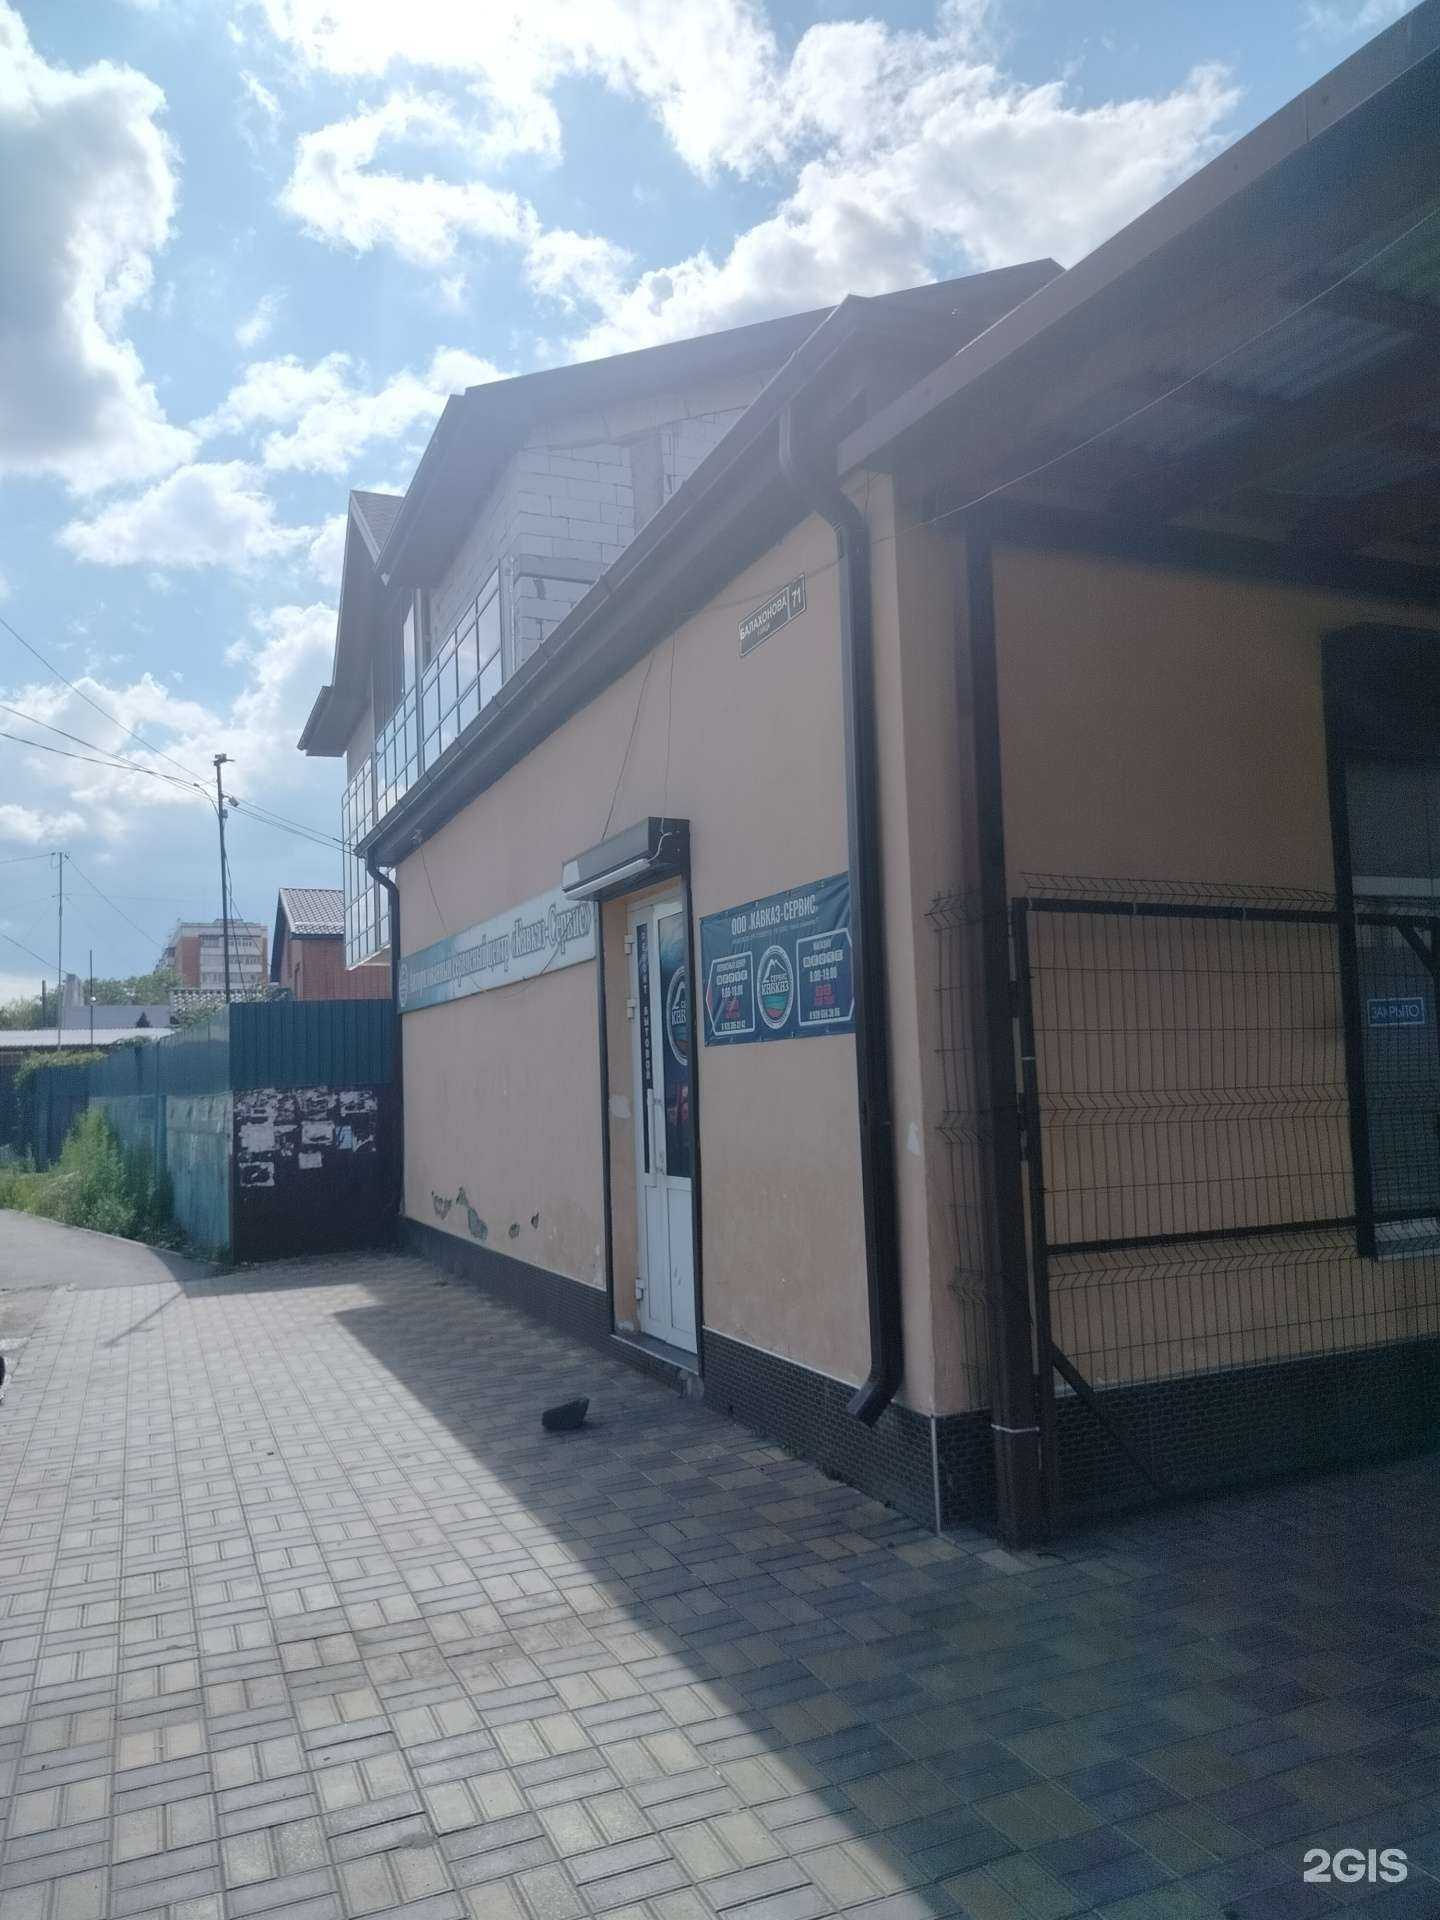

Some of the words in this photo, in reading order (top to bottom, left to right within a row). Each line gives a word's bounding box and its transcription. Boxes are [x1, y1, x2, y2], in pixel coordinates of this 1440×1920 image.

[740, 596, 787, 640] БАЛАХОНОВА
[792, 587, 801, 607] 71
[731, 915, 747, 936] ООО
[750, 894, 816, 930] КАВКАЗ-СЕРВИС
[762, 981, 790, 996] КАВКАЗ
